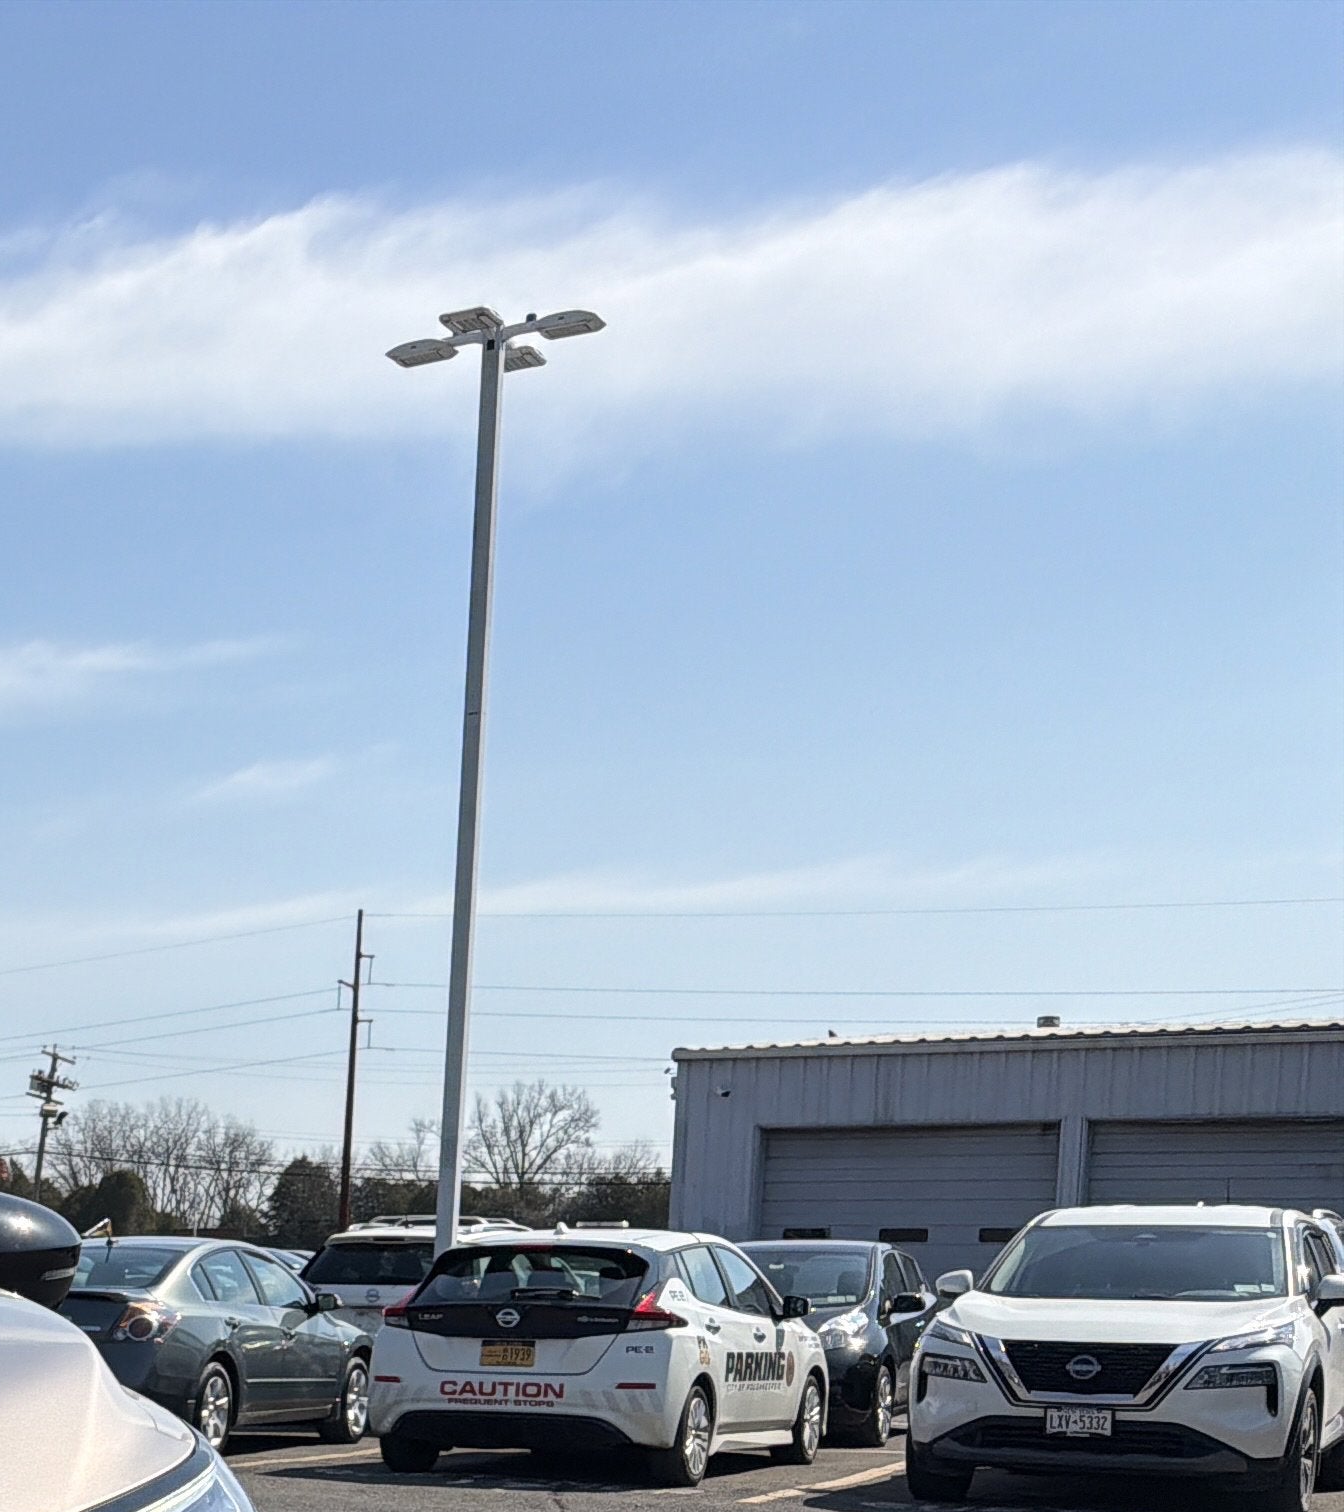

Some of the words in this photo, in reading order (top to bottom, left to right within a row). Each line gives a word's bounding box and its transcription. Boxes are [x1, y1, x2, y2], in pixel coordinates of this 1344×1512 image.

[724, 1351, 786, 1382] PARKING
[439, 1380, 565, 1398] CAUTION
[447, 1398, 509, 1406] FREQUENT
[513, 1400, 554, 1408] STOPS
